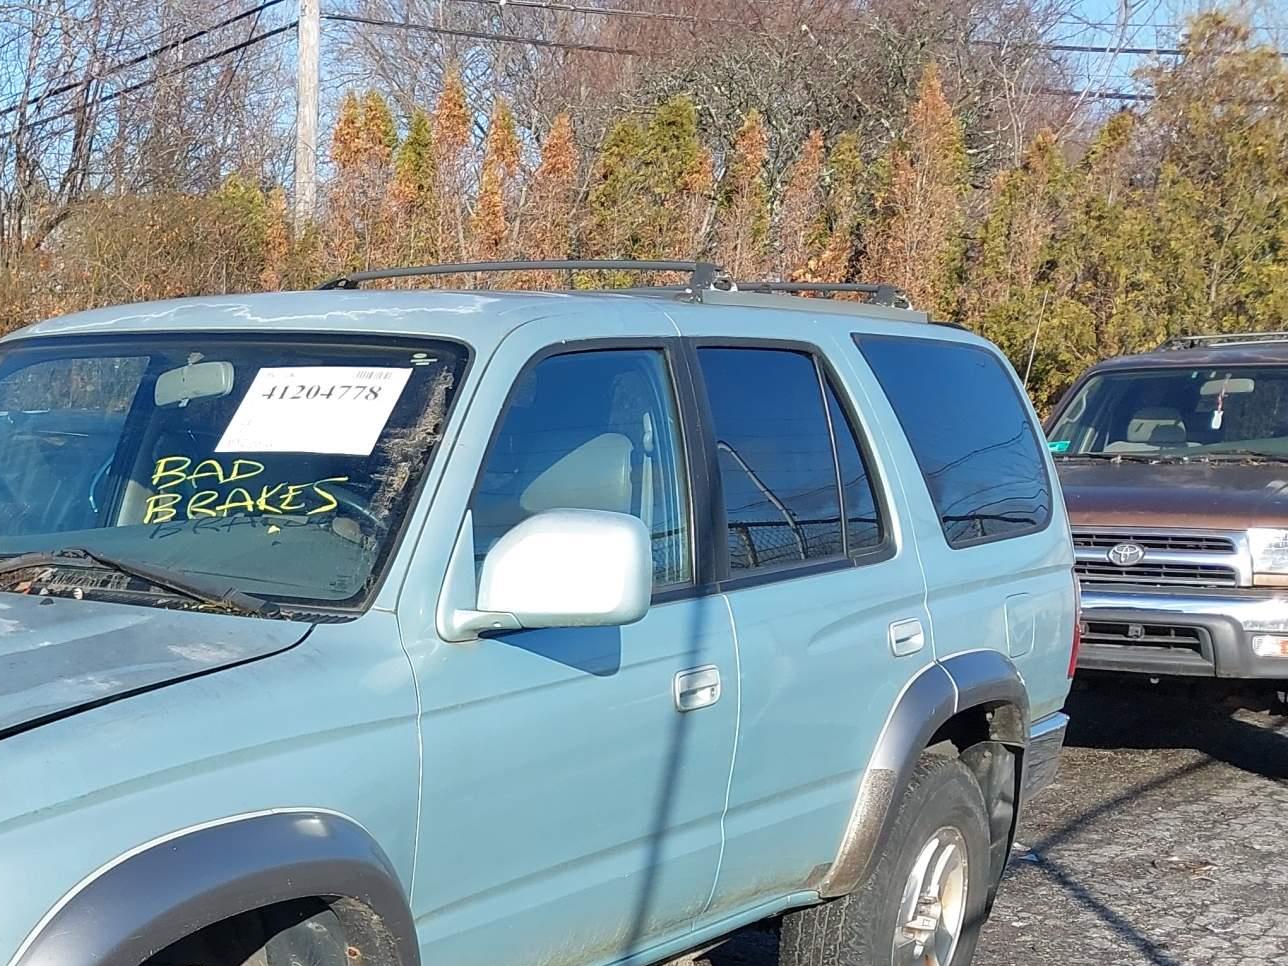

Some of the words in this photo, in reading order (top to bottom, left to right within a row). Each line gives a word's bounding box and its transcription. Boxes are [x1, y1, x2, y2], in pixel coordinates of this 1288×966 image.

[261, 383, 382, 402] 41204778
[152, 456, 265, 489] BAD
[143, 476, 349, 525] BRAKES
